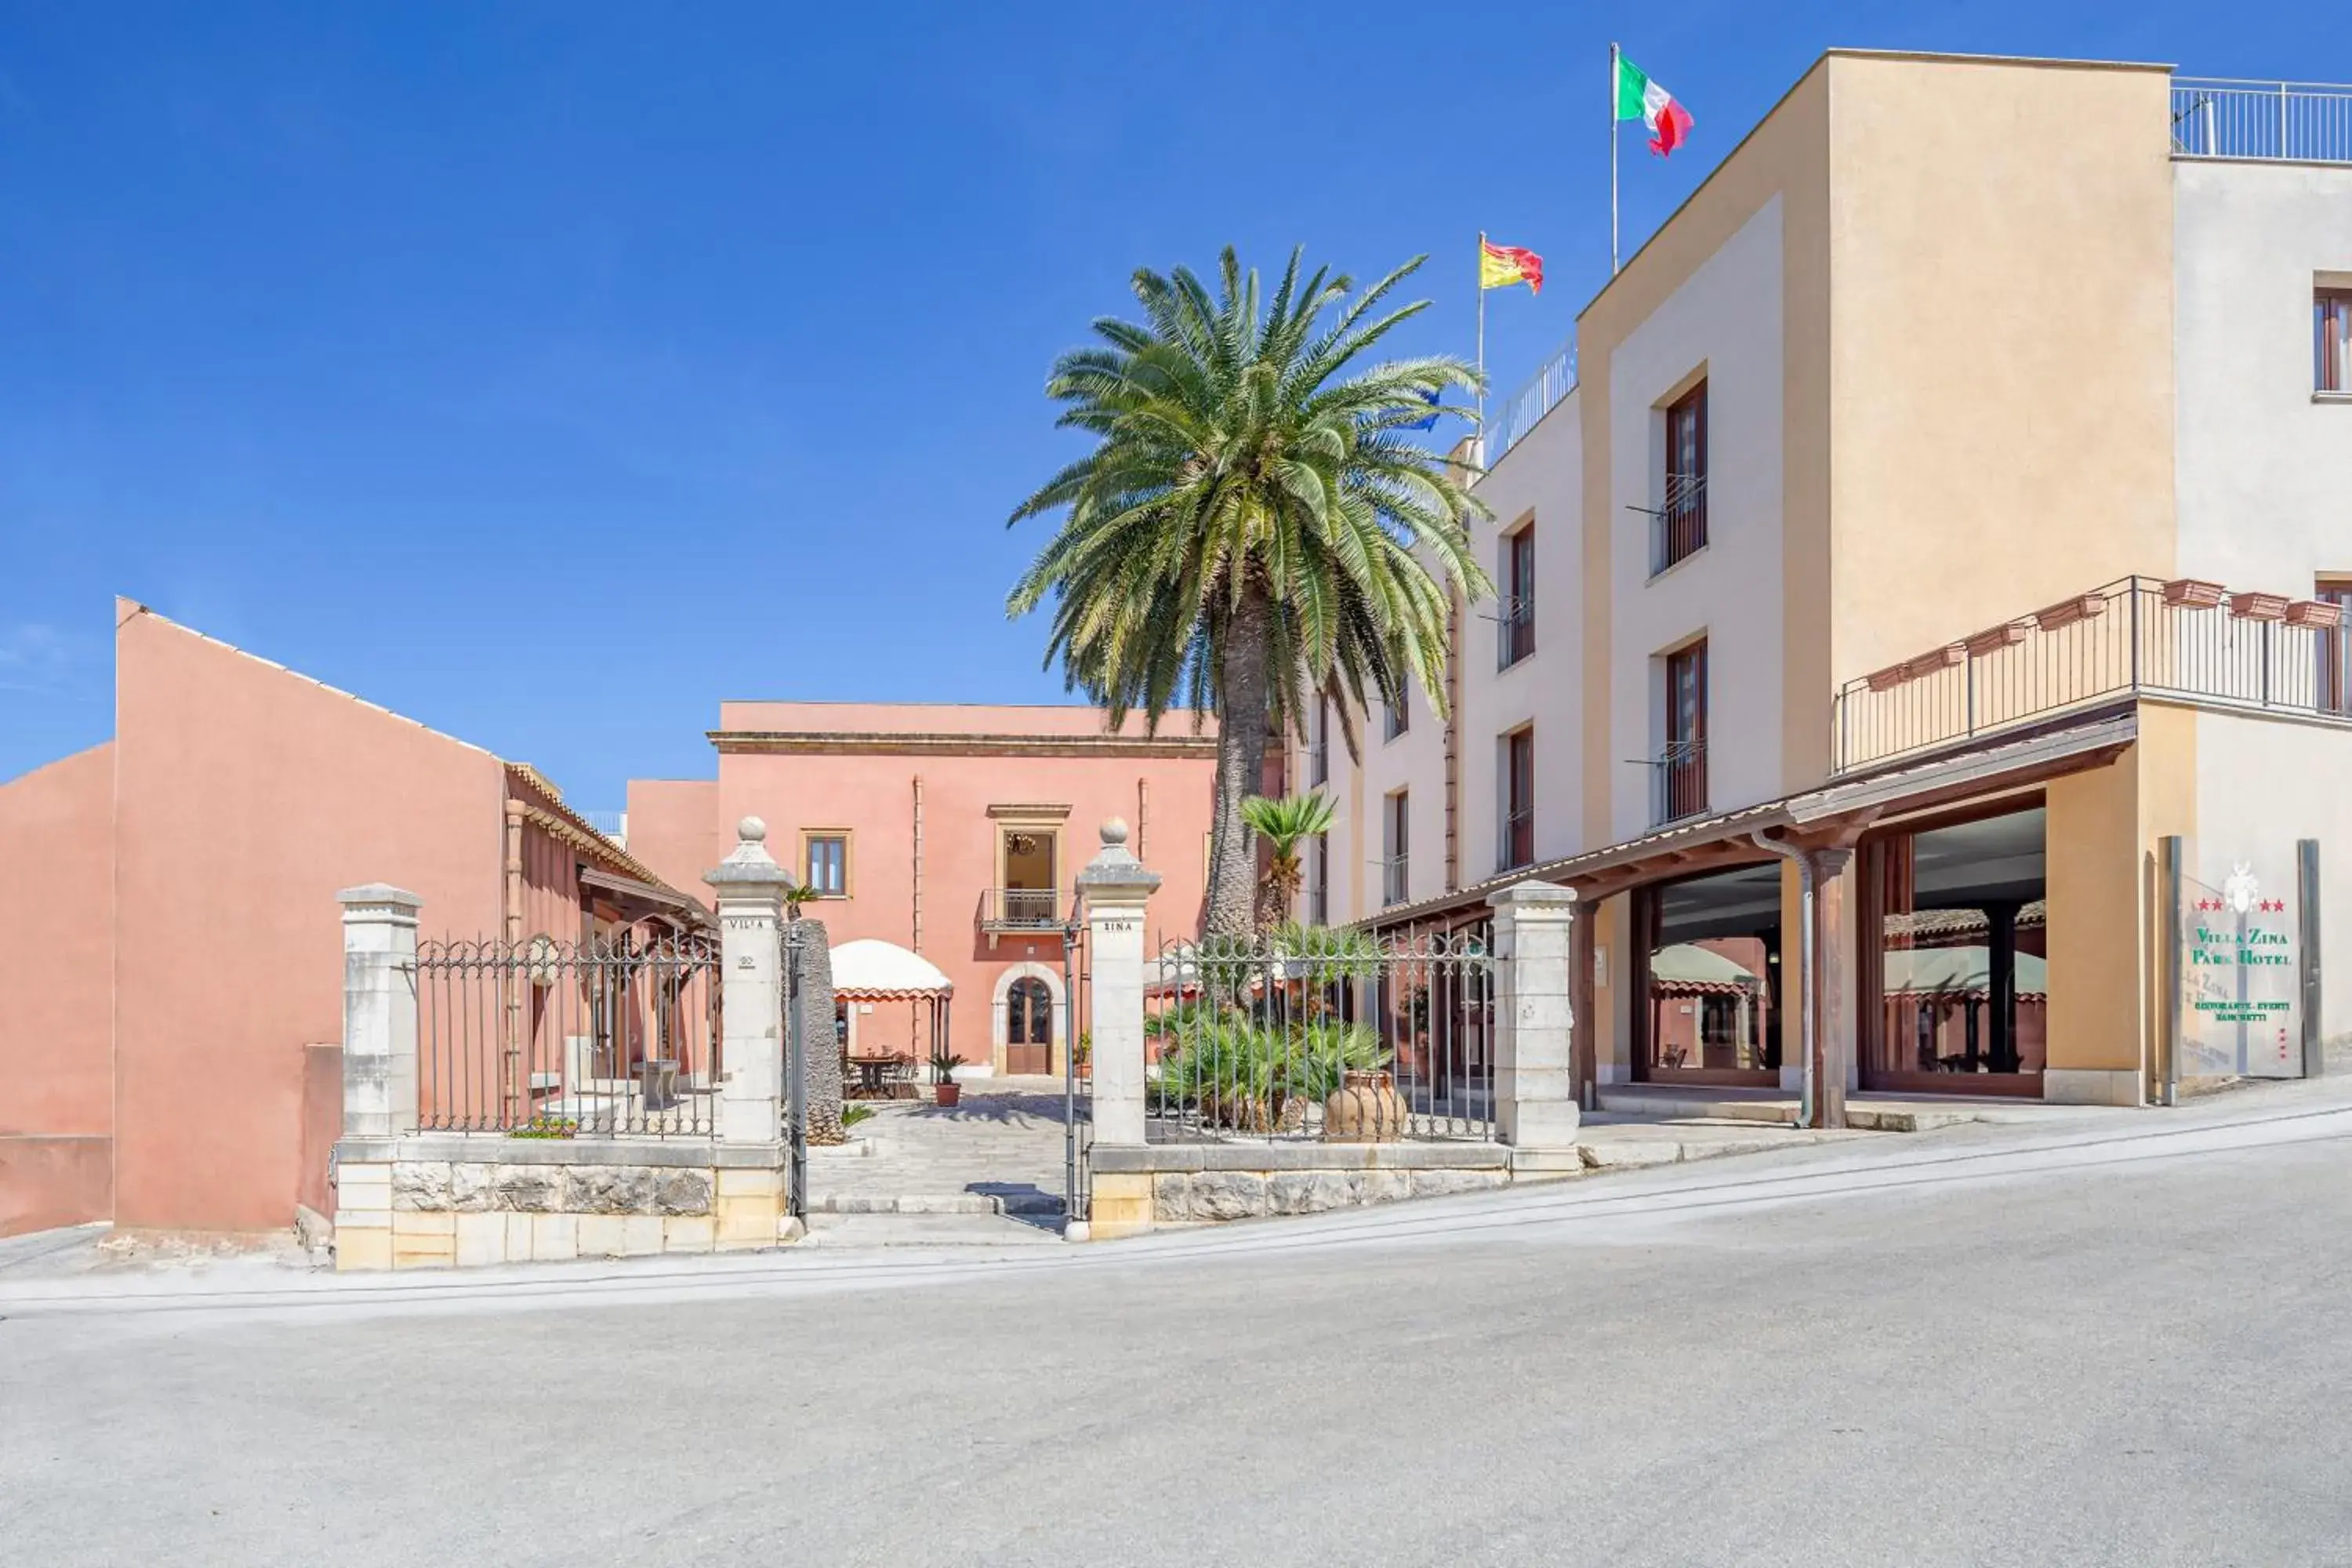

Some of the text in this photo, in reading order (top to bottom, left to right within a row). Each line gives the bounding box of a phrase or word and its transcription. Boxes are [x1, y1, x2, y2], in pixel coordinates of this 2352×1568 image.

[2195, 927, 2288, 945] VILLA ZINA
[2193, 949, 2292, 965] PARK HOTEL
